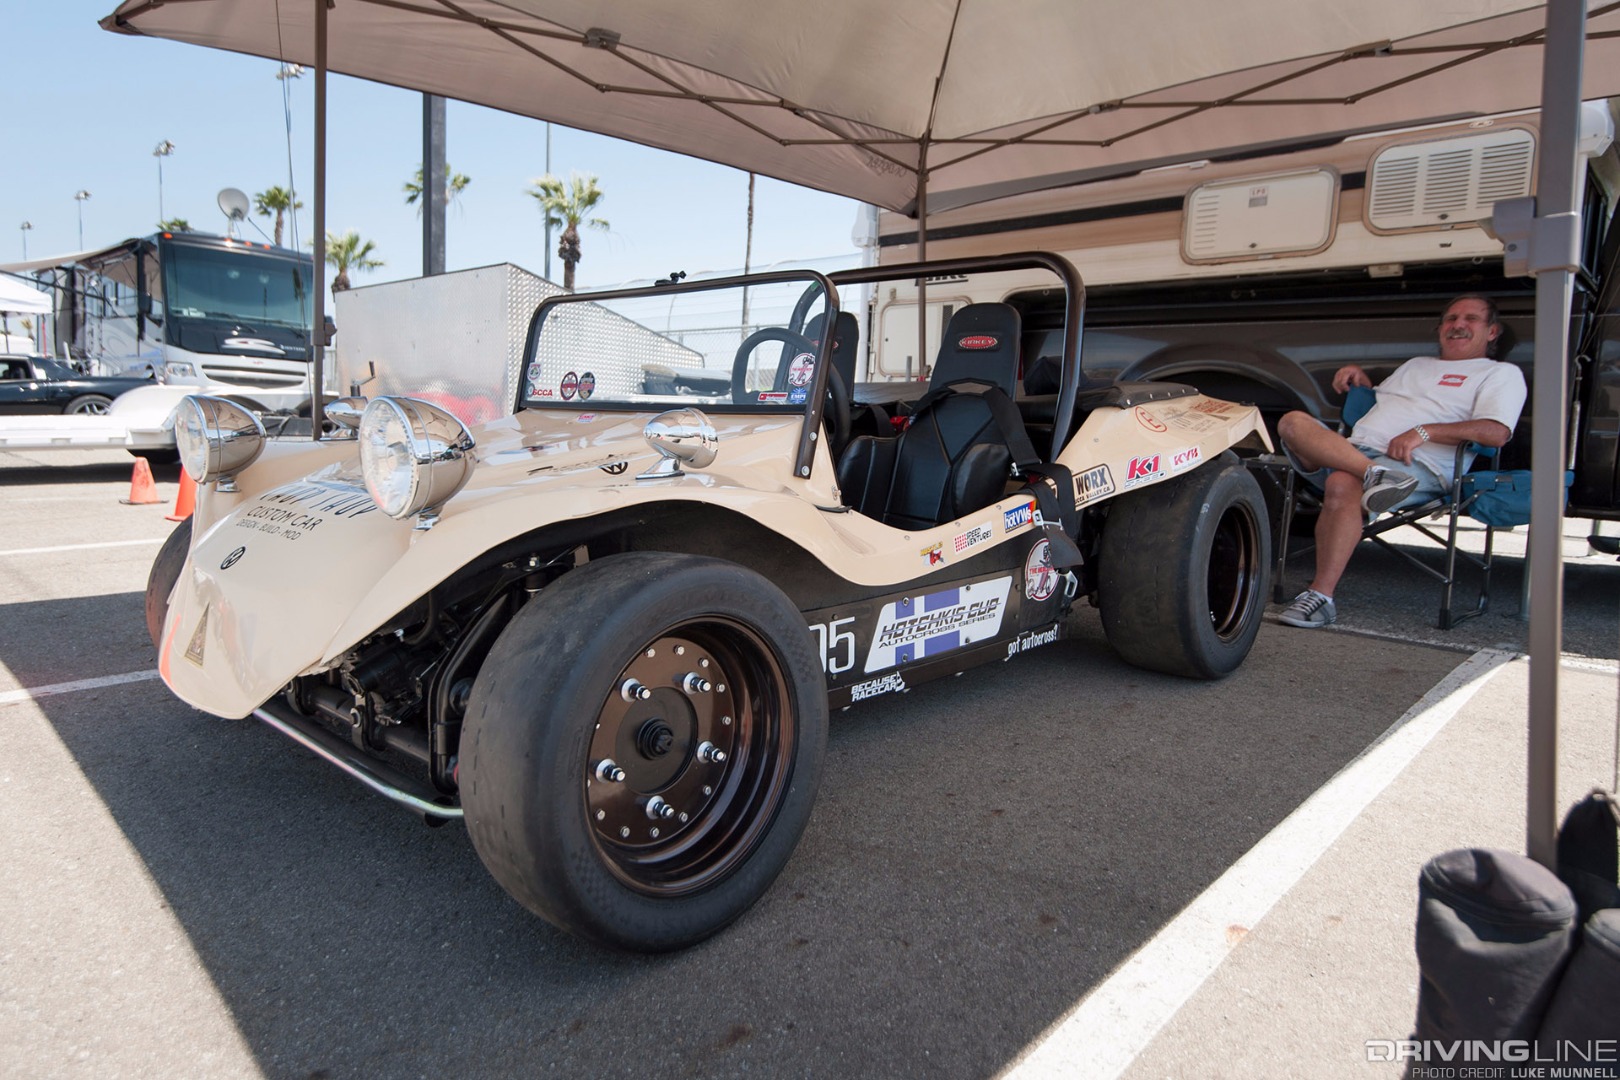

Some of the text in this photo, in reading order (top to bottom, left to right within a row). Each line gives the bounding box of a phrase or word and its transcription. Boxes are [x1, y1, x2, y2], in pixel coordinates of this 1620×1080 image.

[1128, 455, 1160, 480] K1
[236, 518, 301, 541] DESIGN BUILD MOD
[246, 505, 323, 531] CUSTOM CAR
[879, 612, 996, 648] AUTOCROSS SERIES
[880, 598, 1000, 642] HOTCHKIS CUP
[1008, 623, 1058, 658] got autocross?
[851, 674, 897, 695] BECAUSE
[851, 682, 897, 702] RACECAR
